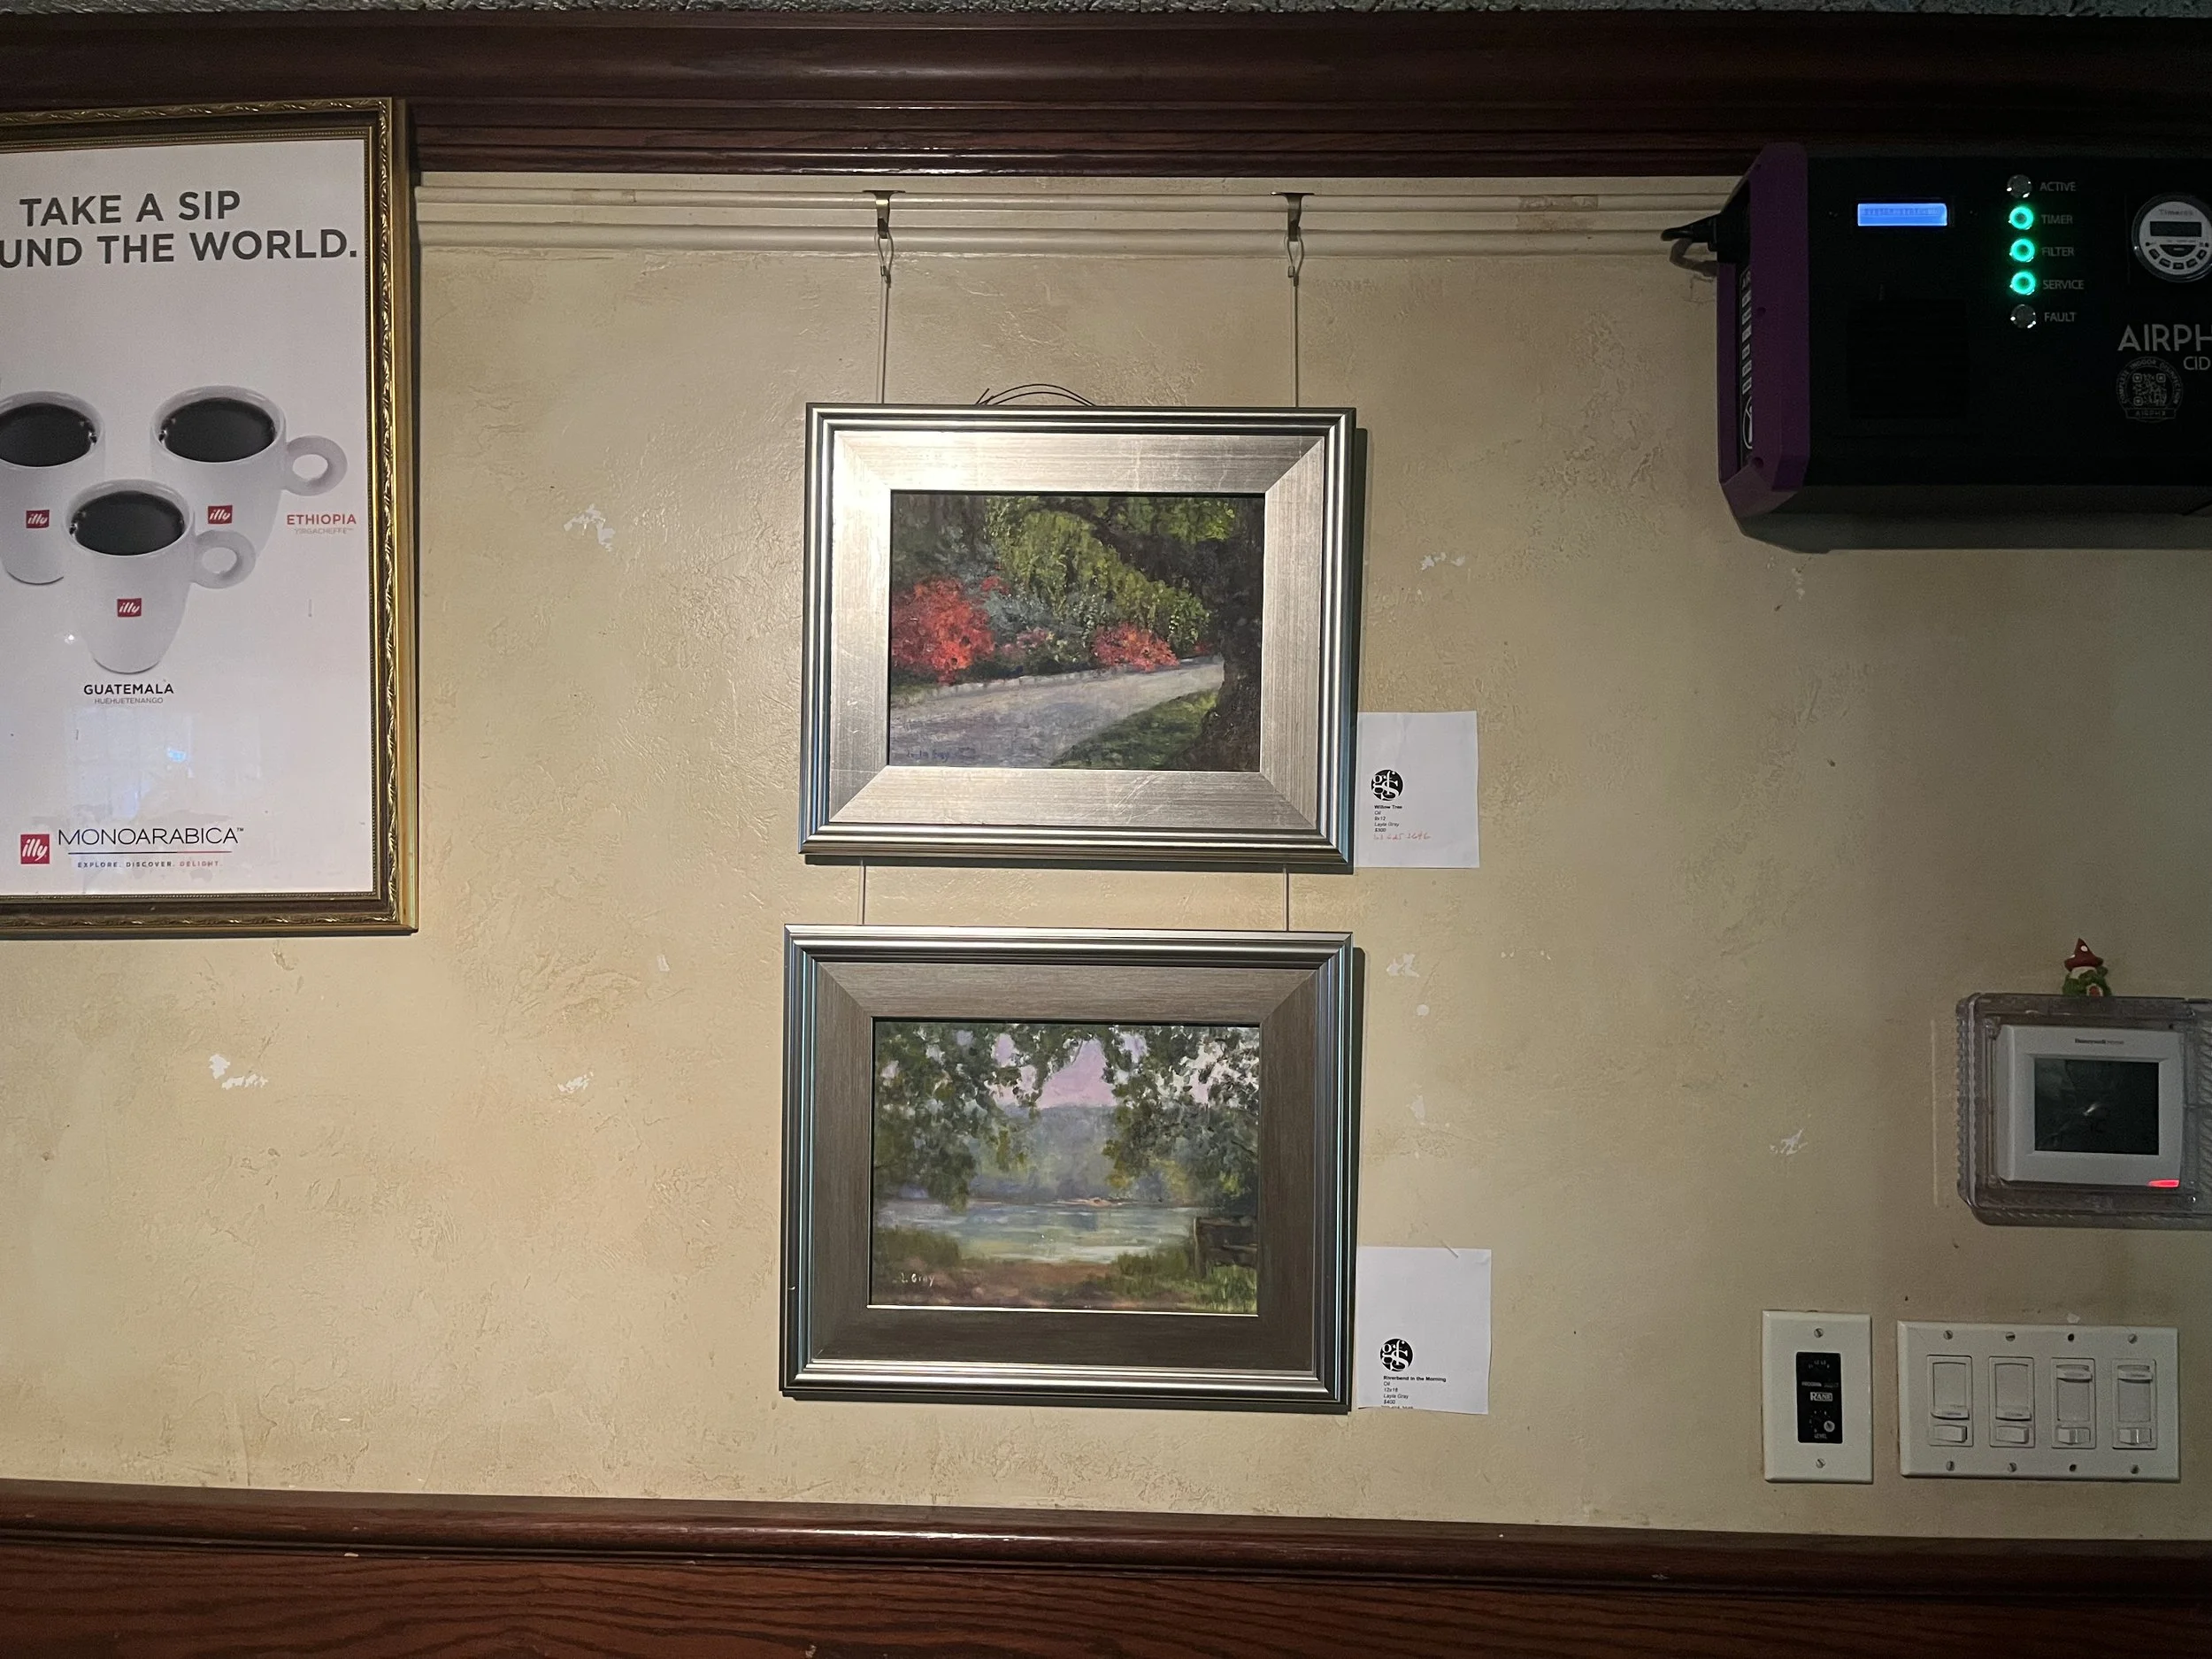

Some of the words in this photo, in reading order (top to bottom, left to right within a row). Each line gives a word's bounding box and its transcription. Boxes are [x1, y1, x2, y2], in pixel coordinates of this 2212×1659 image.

[2039, 180, 2078, 192] ACTIVE
[19, 194, 122, 227] TAKE
[135, 193, 165, 222] A
[178, 190, 241, 221] SIP
[2041, 214, 2074, 225] TIMER
[0, 237, 83, 269] UND
[96, 233, 175, 265] THE
[188, 228, 357, 262] WORLD.
[2041, 246, 2076, 257] FILTER
[2042, 279, 2085, 290] SERVICE
[2044, 311, 2078, 323] FAULT
[27, 513, 48, 526] illy
[208, 508, 229, 523] illy
[286, 513, 357, 525] ETHIOPIA
[118, 602, 140, 616] illy
[83, 683, 174, 695] GUATEMALA
[94, 696, 164, 705] HUEHUETENANGO
[22, 839, 48, 862] illy
